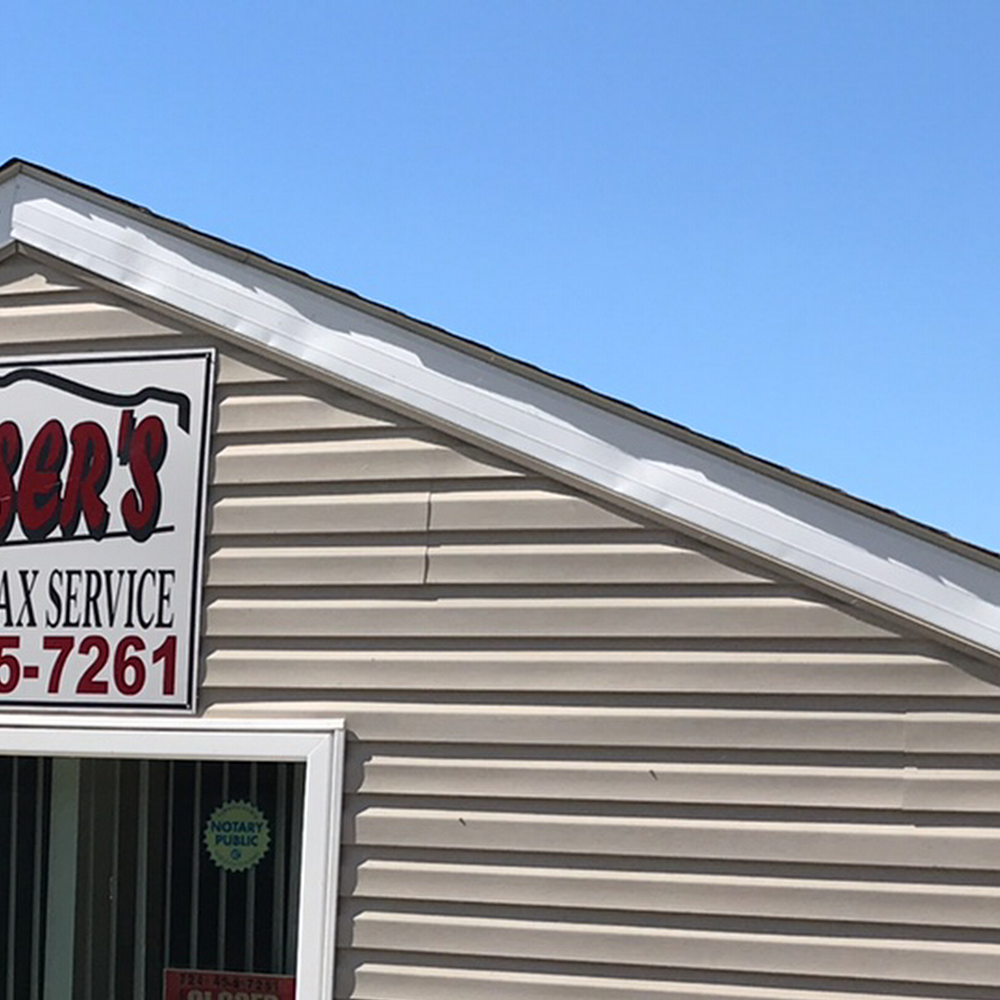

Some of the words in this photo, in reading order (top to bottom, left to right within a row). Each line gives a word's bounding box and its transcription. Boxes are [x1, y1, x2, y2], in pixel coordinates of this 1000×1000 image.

[46, 569, 176, 629] SERVICE
[211, 821, 264, 833] NOTARY
[215, 834, 259, 847] PUBLIC
